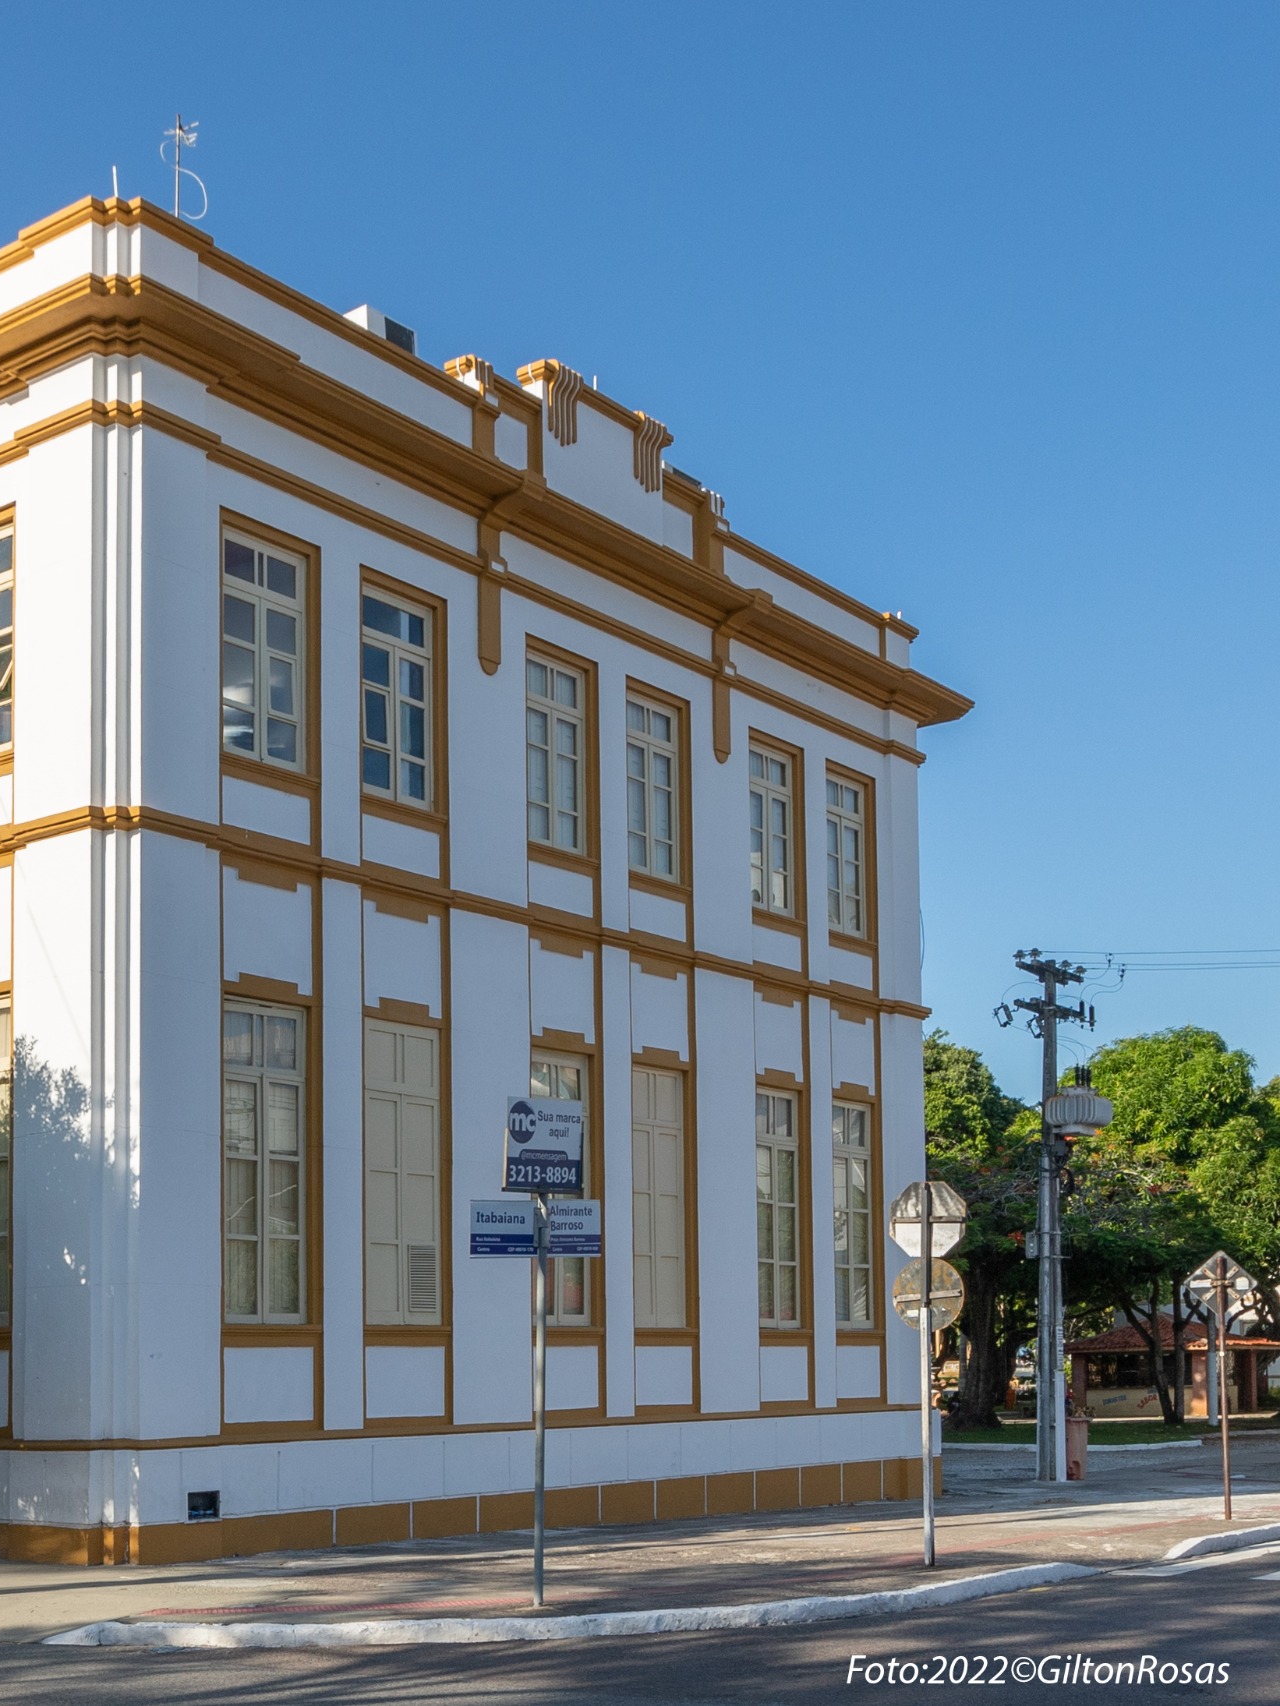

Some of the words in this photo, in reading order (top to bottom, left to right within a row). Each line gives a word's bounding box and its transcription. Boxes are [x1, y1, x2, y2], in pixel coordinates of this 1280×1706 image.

[509, 1112, 536, 1132] mc
[537, 1110, 554, 1122] Sua
[555, 1113, 581, 1124] marca
[549, 1127, 570, 1140] aqui!
[521, 1151, 567, 1162] @mcmensagem
[508, 1165, 577, 1184] 3213-8894
[549, 1205, 593, 1217] Almirante
[476, 1211, 526, 1225] Itabaiana
[550, 1220, 584, 1231] Barroso
